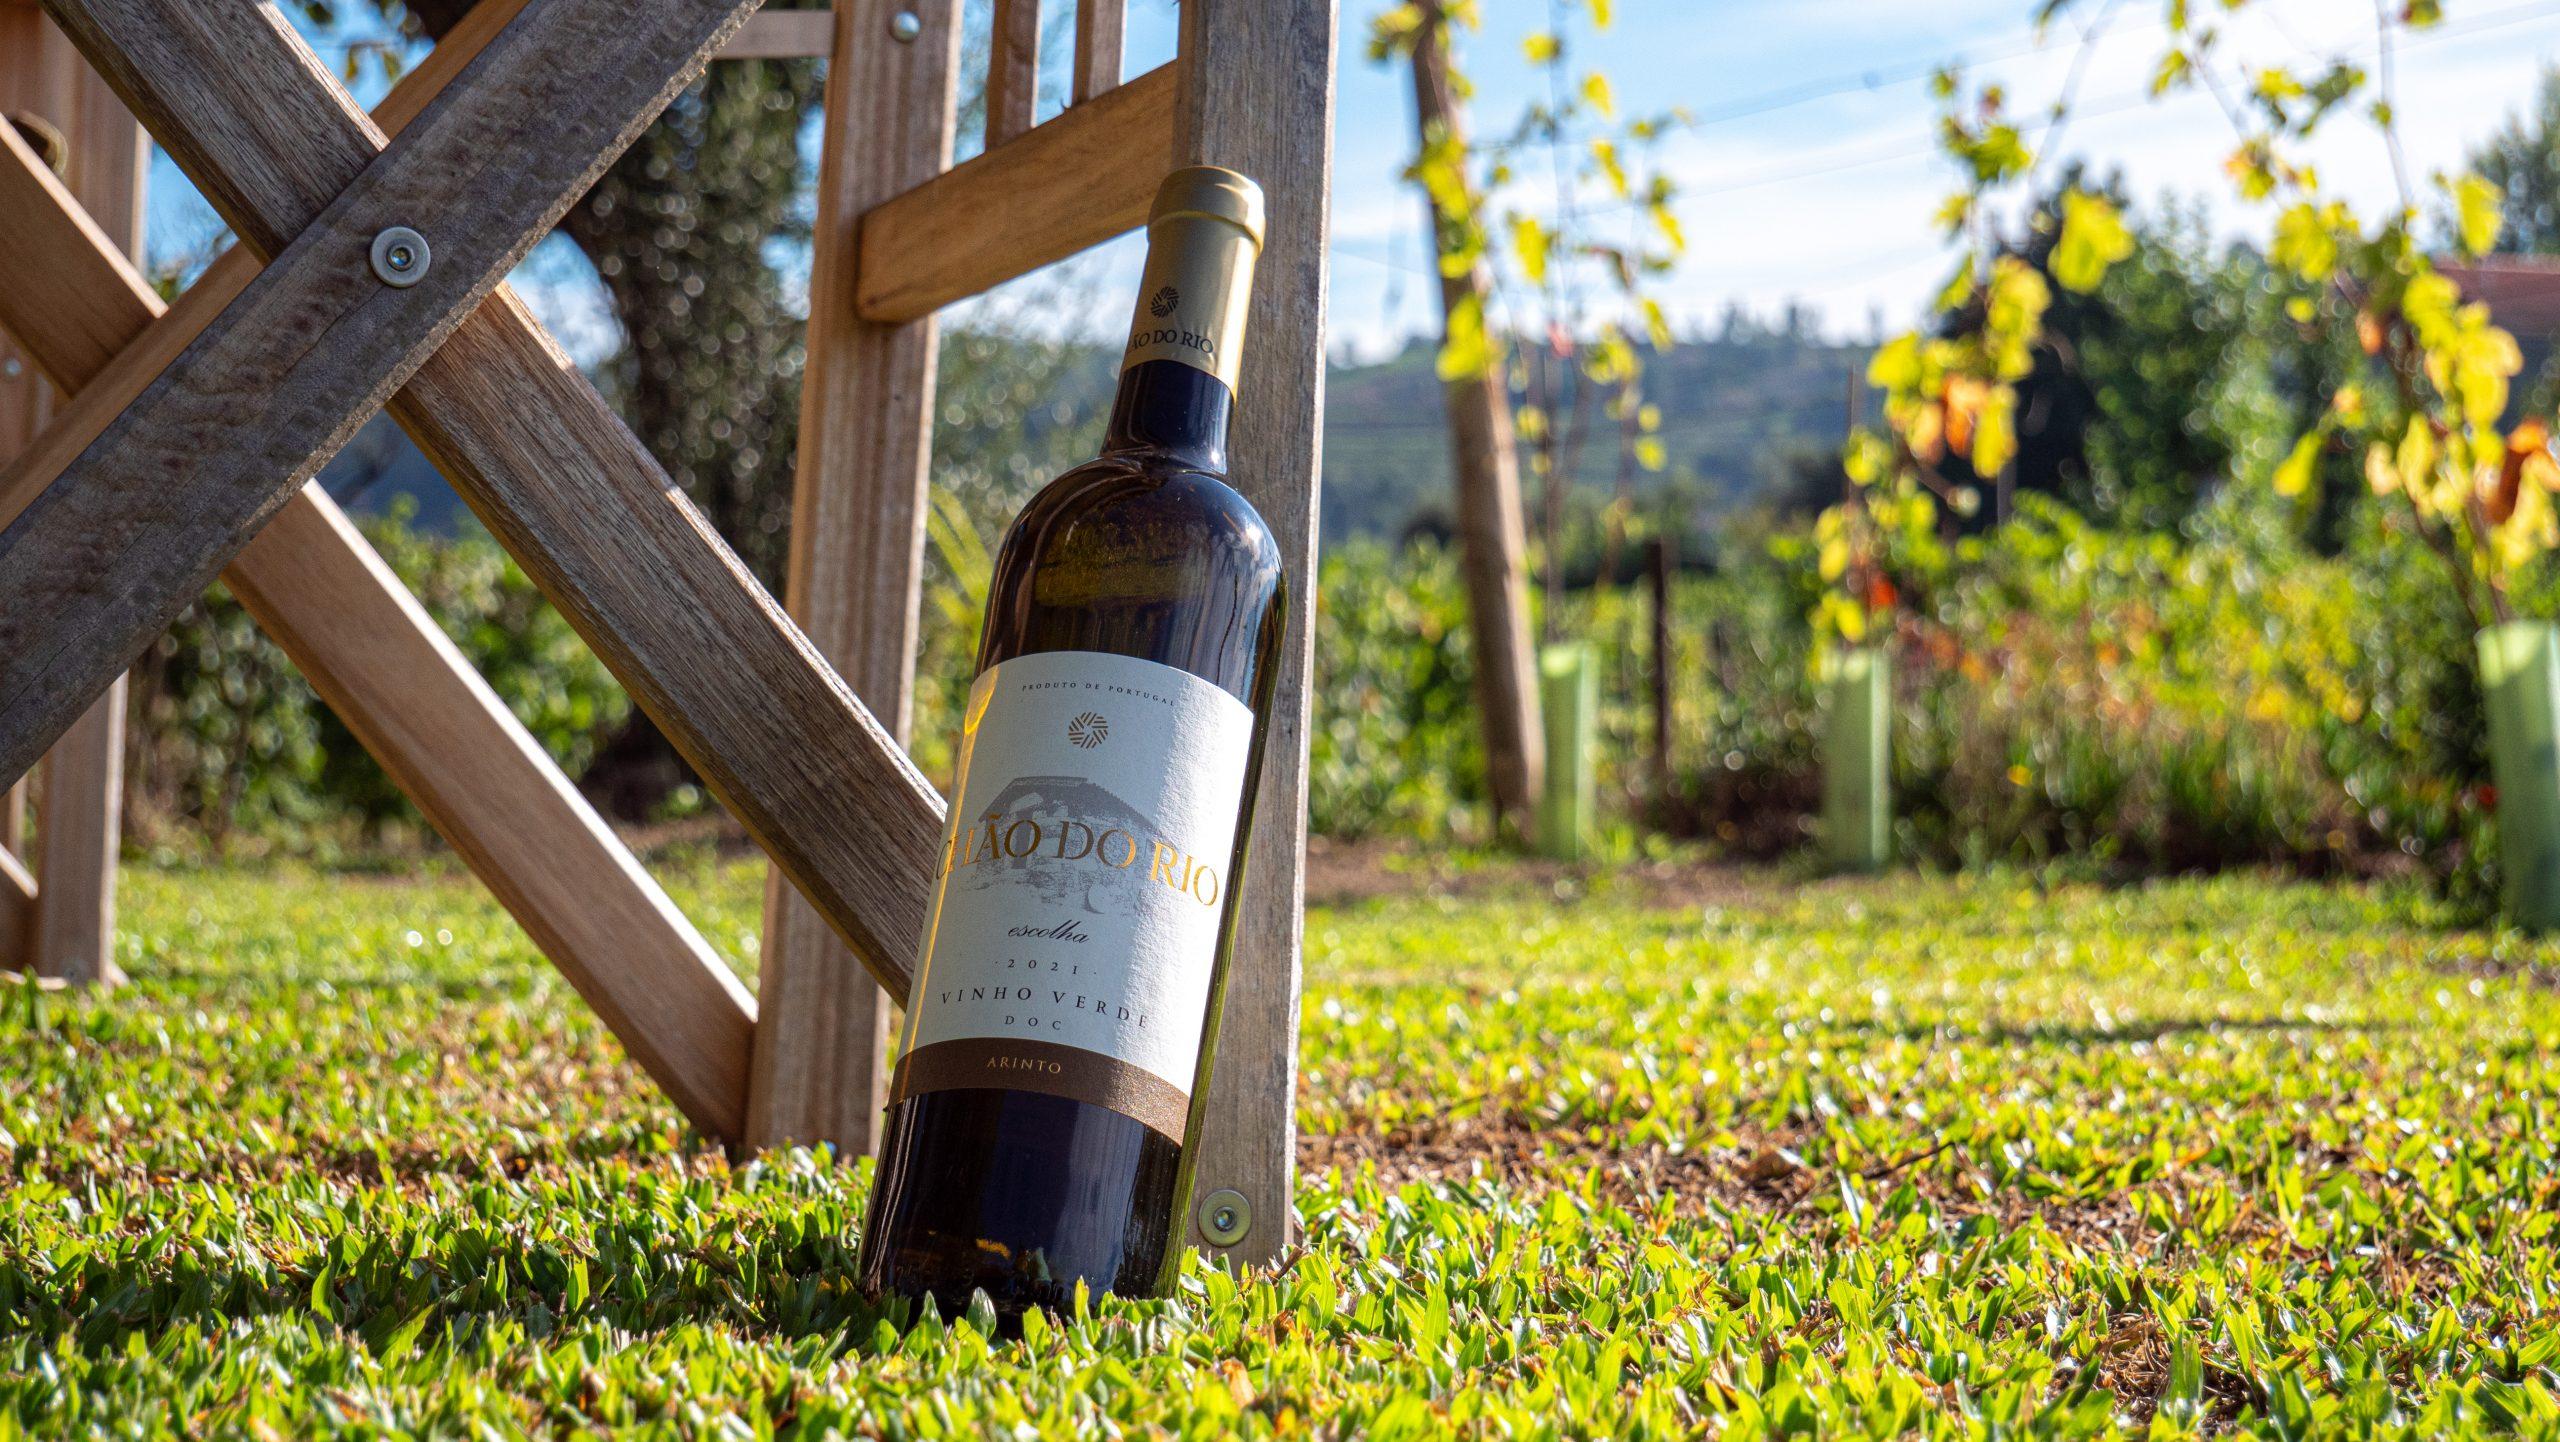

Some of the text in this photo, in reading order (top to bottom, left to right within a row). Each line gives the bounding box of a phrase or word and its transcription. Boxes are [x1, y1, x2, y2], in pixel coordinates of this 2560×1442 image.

[1152, 329, 1178, 344] DO
[1179, 331, 1214, 354] RIO
[1022, 682, 1177, 706] PRODUTO DE PORTUGAL
[1053, 820, 1137, 870] DO
[1148, 840, 1219, 907] RIO
[1007, 919, 1090, 944] escolha
[941, 987, 1149, 1029] VINHO VERDE
[1005, 1015, 1062, 1031] DOC
[986, 1056, 1062, 1075] ARINTO
